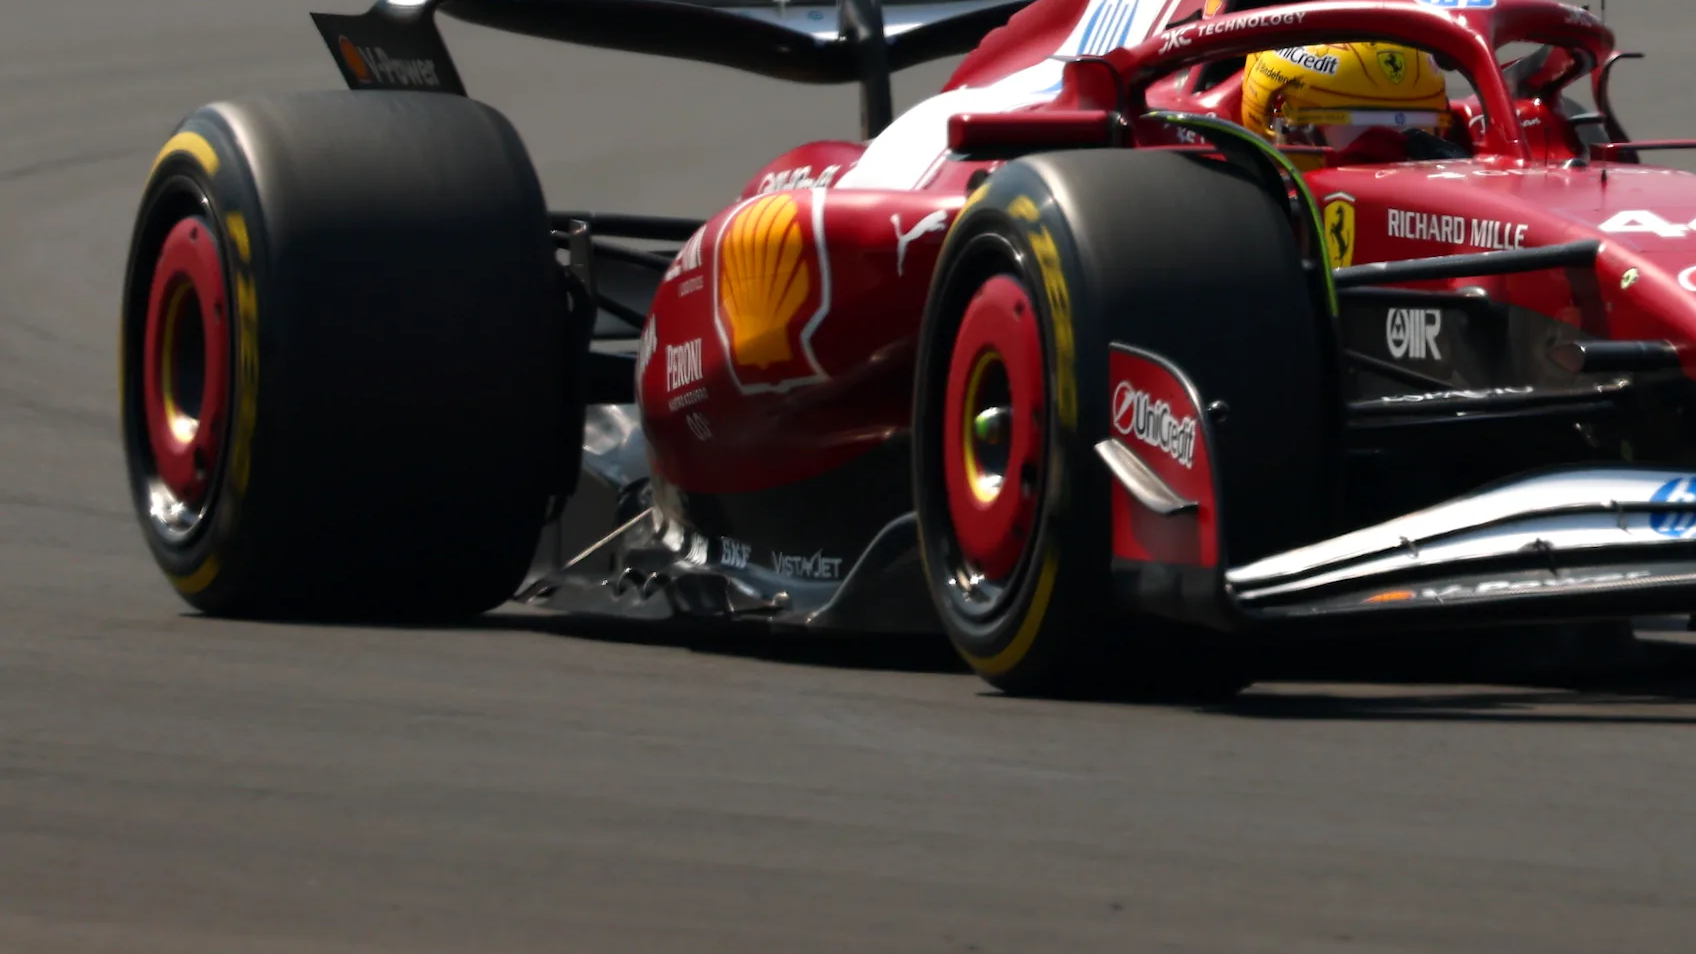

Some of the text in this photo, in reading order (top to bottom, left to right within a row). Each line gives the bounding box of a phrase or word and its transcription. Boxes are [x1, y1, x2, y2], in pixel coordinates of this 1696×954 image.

[1198, 12, 1306, 38] TECHNOLOGY
[1274, 47, 1338, 76] niCredit
[1388, 208, 1528, 250] RICHARD MILLE
[666, 337, 703, 393] PERONI
[1134, 389, 1197, 469] UniCredit
